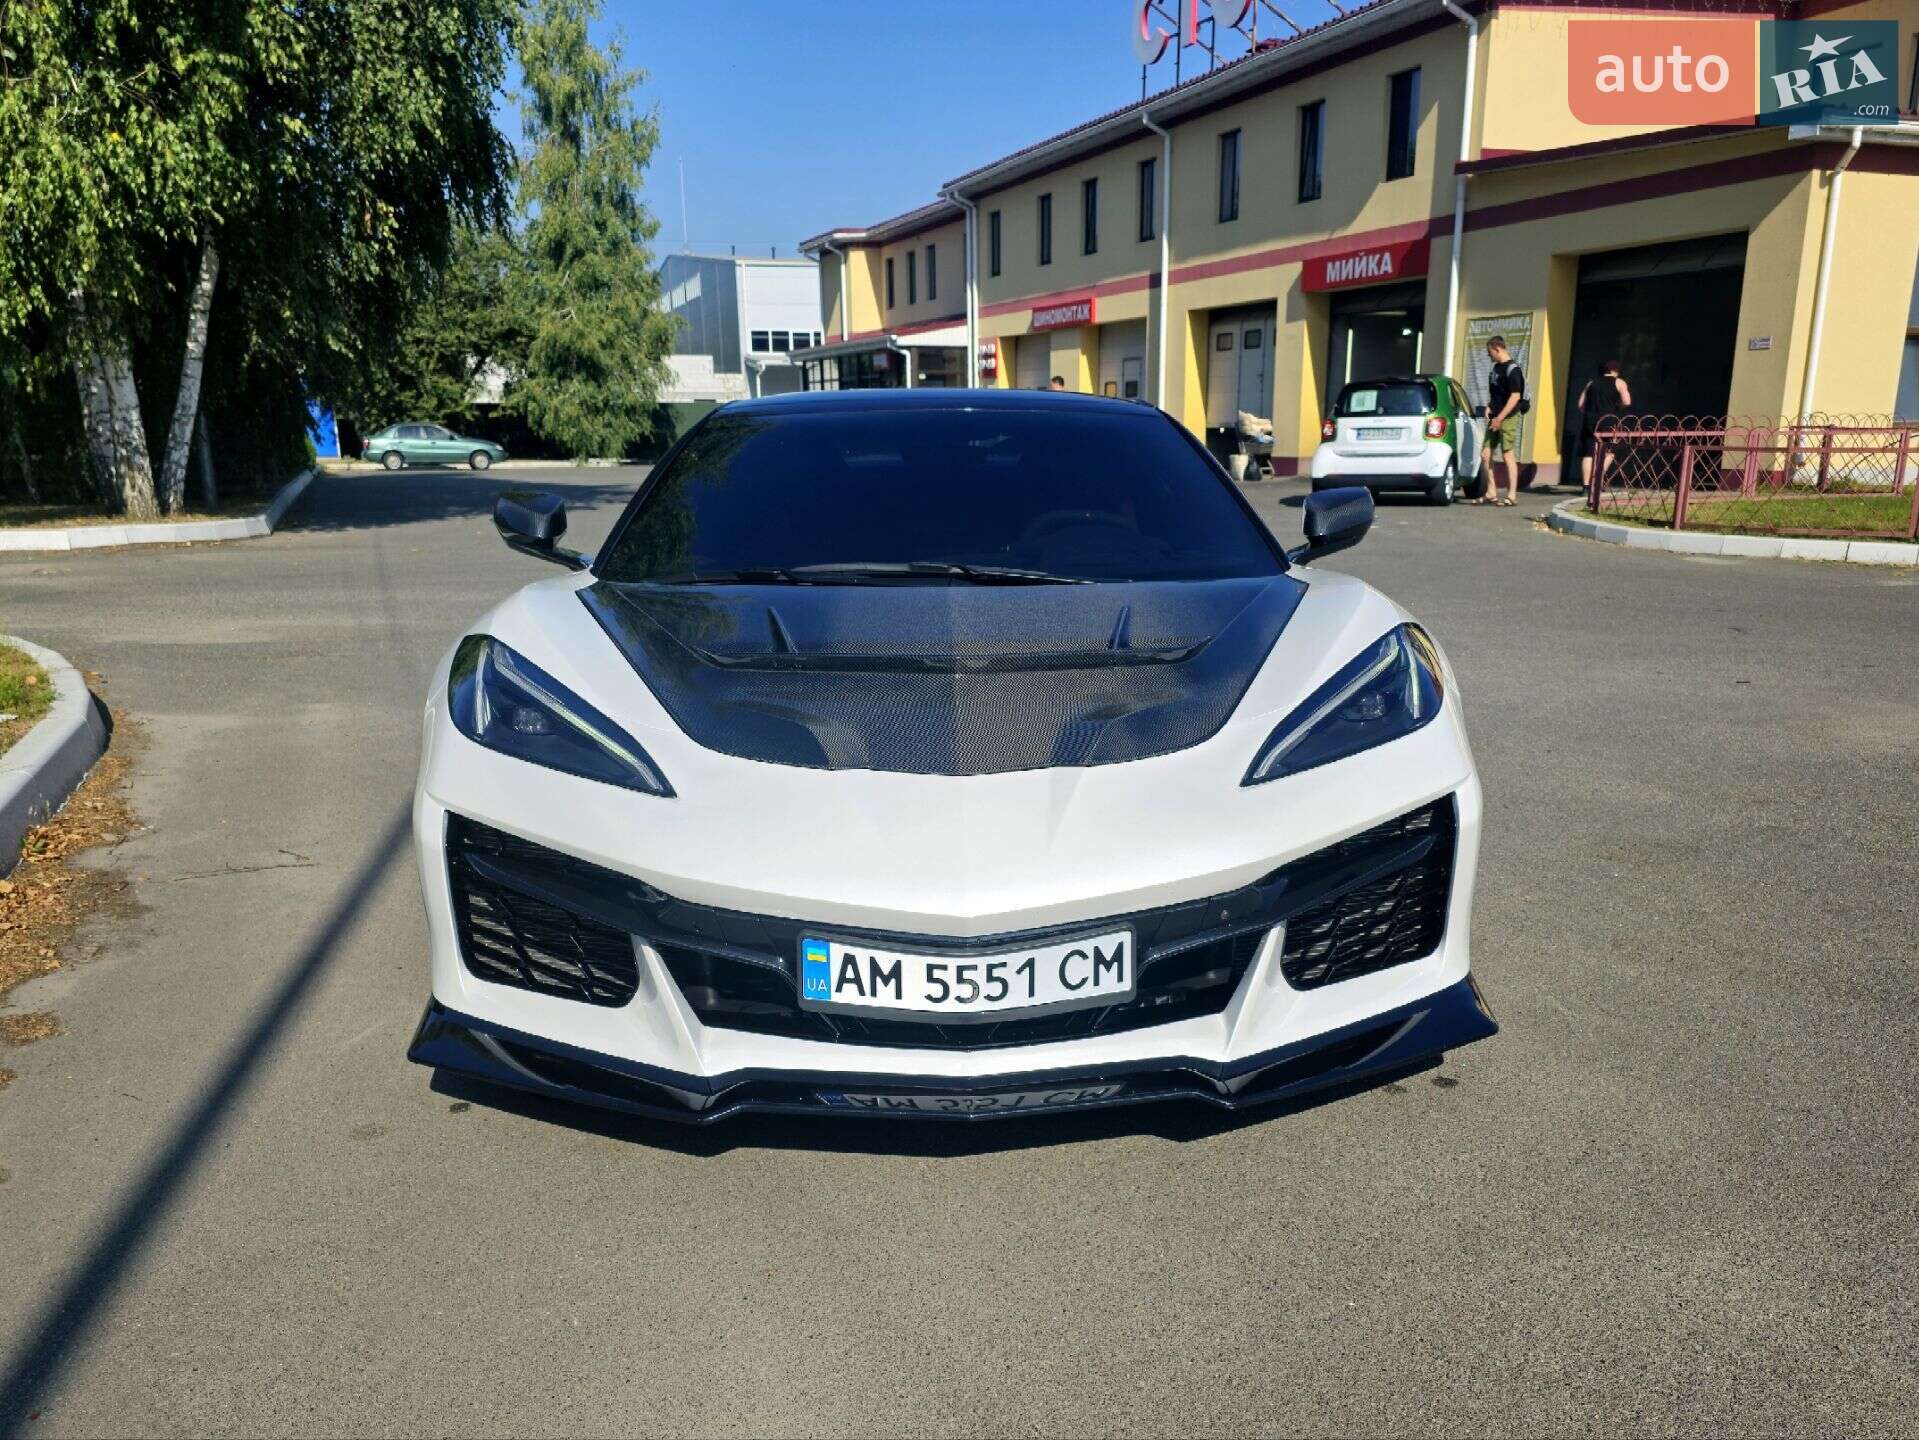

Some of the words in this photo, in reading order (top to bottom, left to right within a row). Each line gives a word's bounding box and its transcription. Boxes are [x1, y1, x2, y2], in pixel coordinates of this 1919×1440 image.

[1327, 252, 1392, 283] МИЙКА
[807, 978, 828, 992] UA
[835, 952, 903, 998] AM
[924, 957, 1036, 1004] 5551
[1058, 941, 1125, 991] CM
